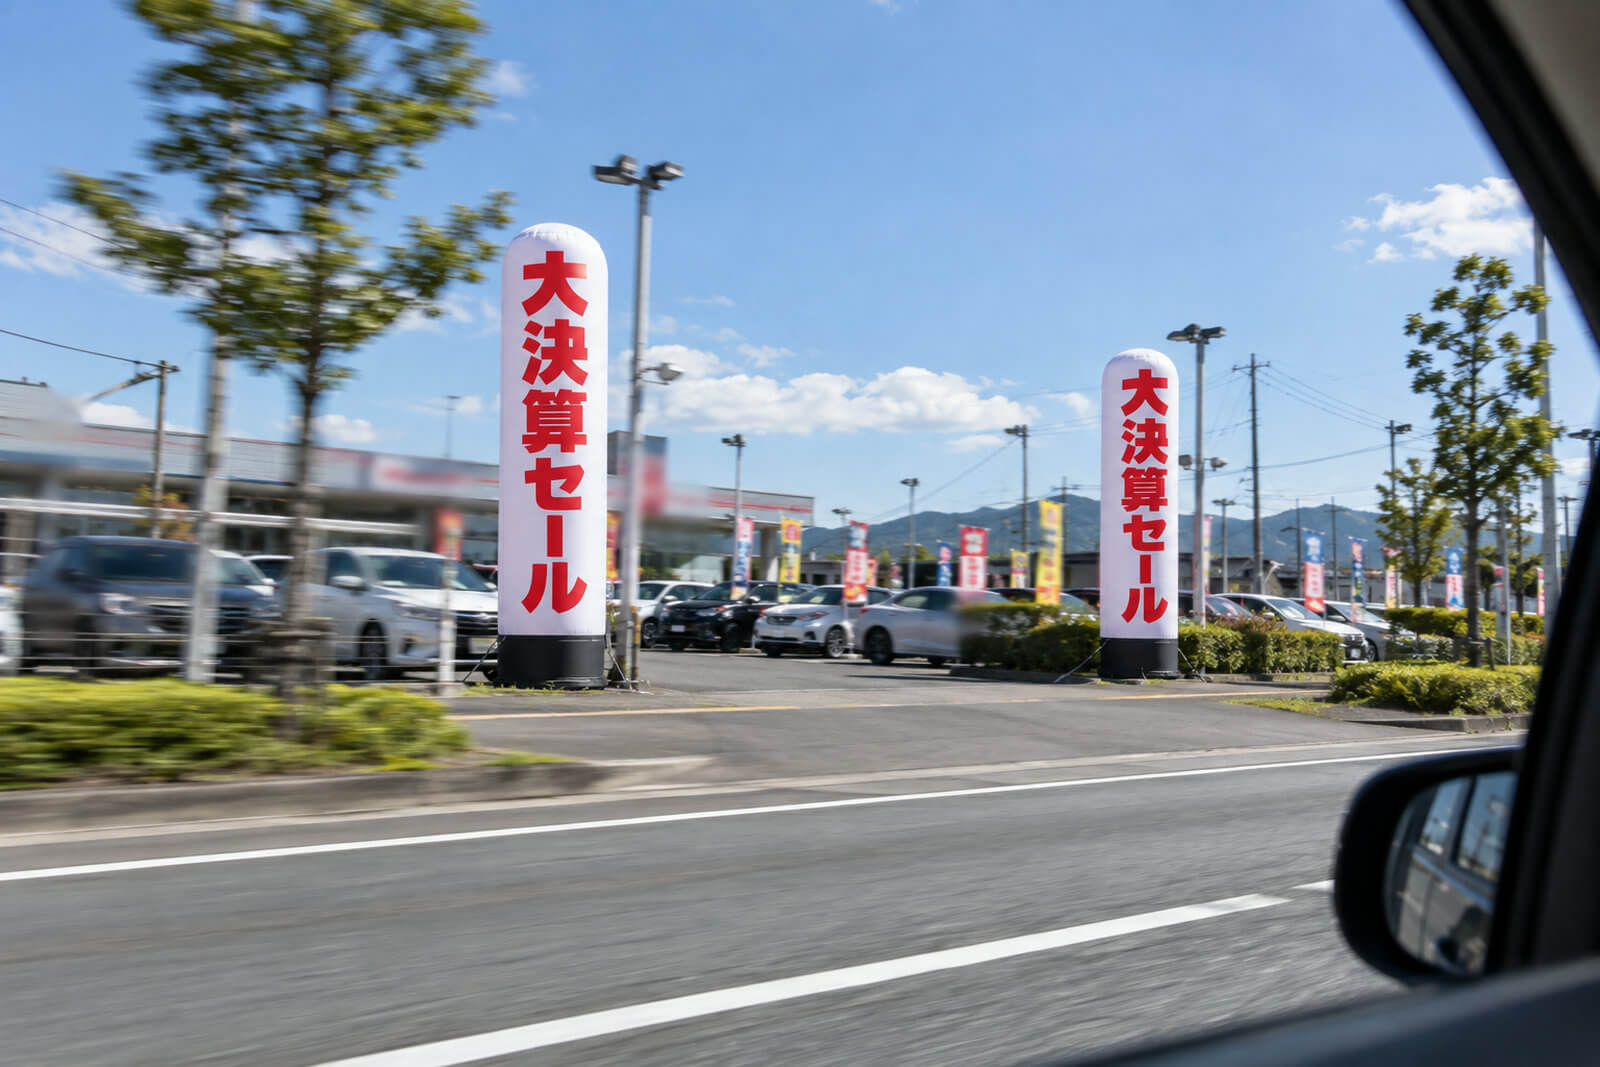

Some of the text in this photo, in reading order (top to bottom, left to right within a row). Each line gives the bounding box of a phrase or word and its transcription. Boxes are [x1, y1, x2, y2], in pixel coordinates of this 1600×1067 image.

[522, 251, 588, 613] 大決算セール
[1121, 368, 1168, 623] 大決算セール
